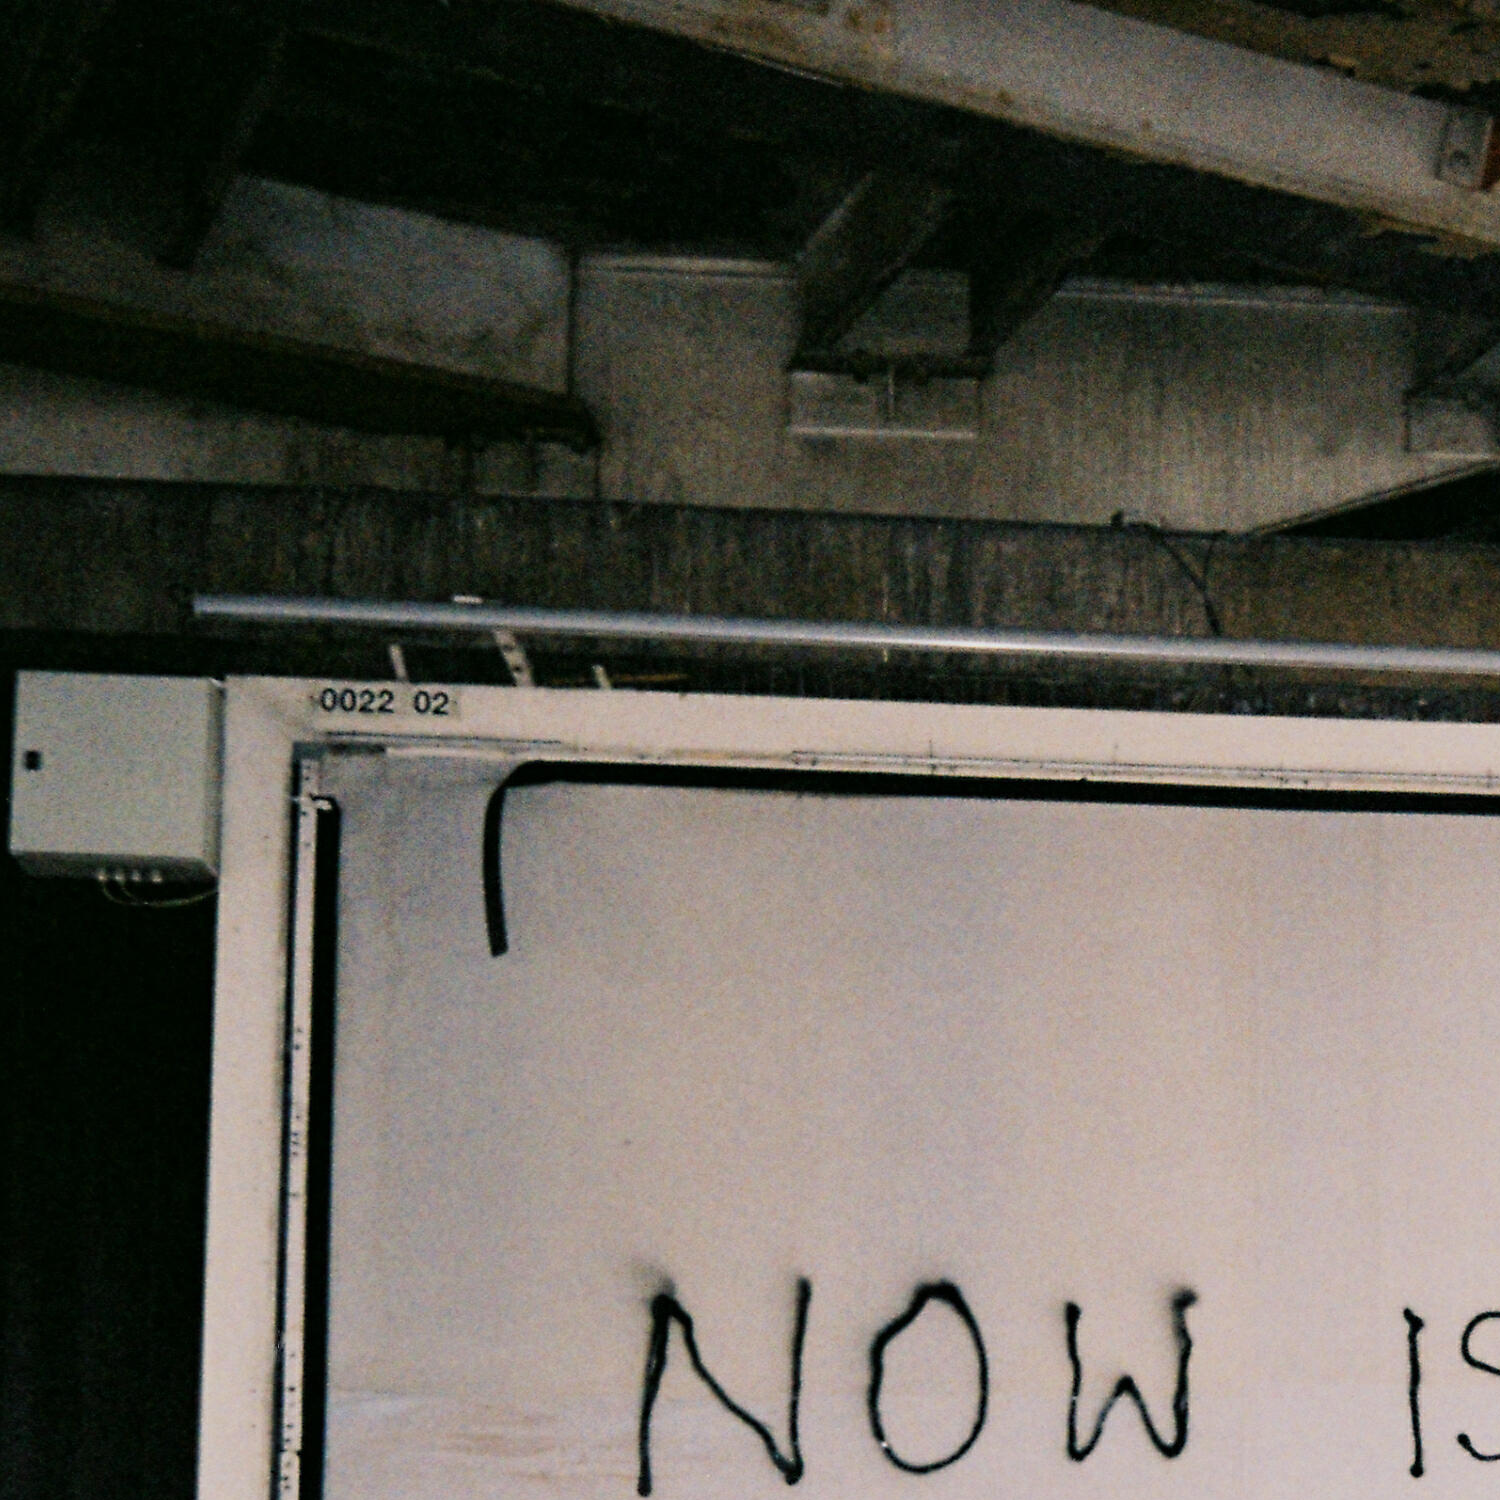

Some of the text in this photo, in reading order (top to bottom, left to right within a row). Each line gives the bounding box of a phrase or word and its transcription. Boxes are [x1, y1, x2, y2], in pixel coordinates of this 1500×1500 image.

[320, 687, 449, 716] 0022 02
[636, 1276, 1198, 1497] NOW
